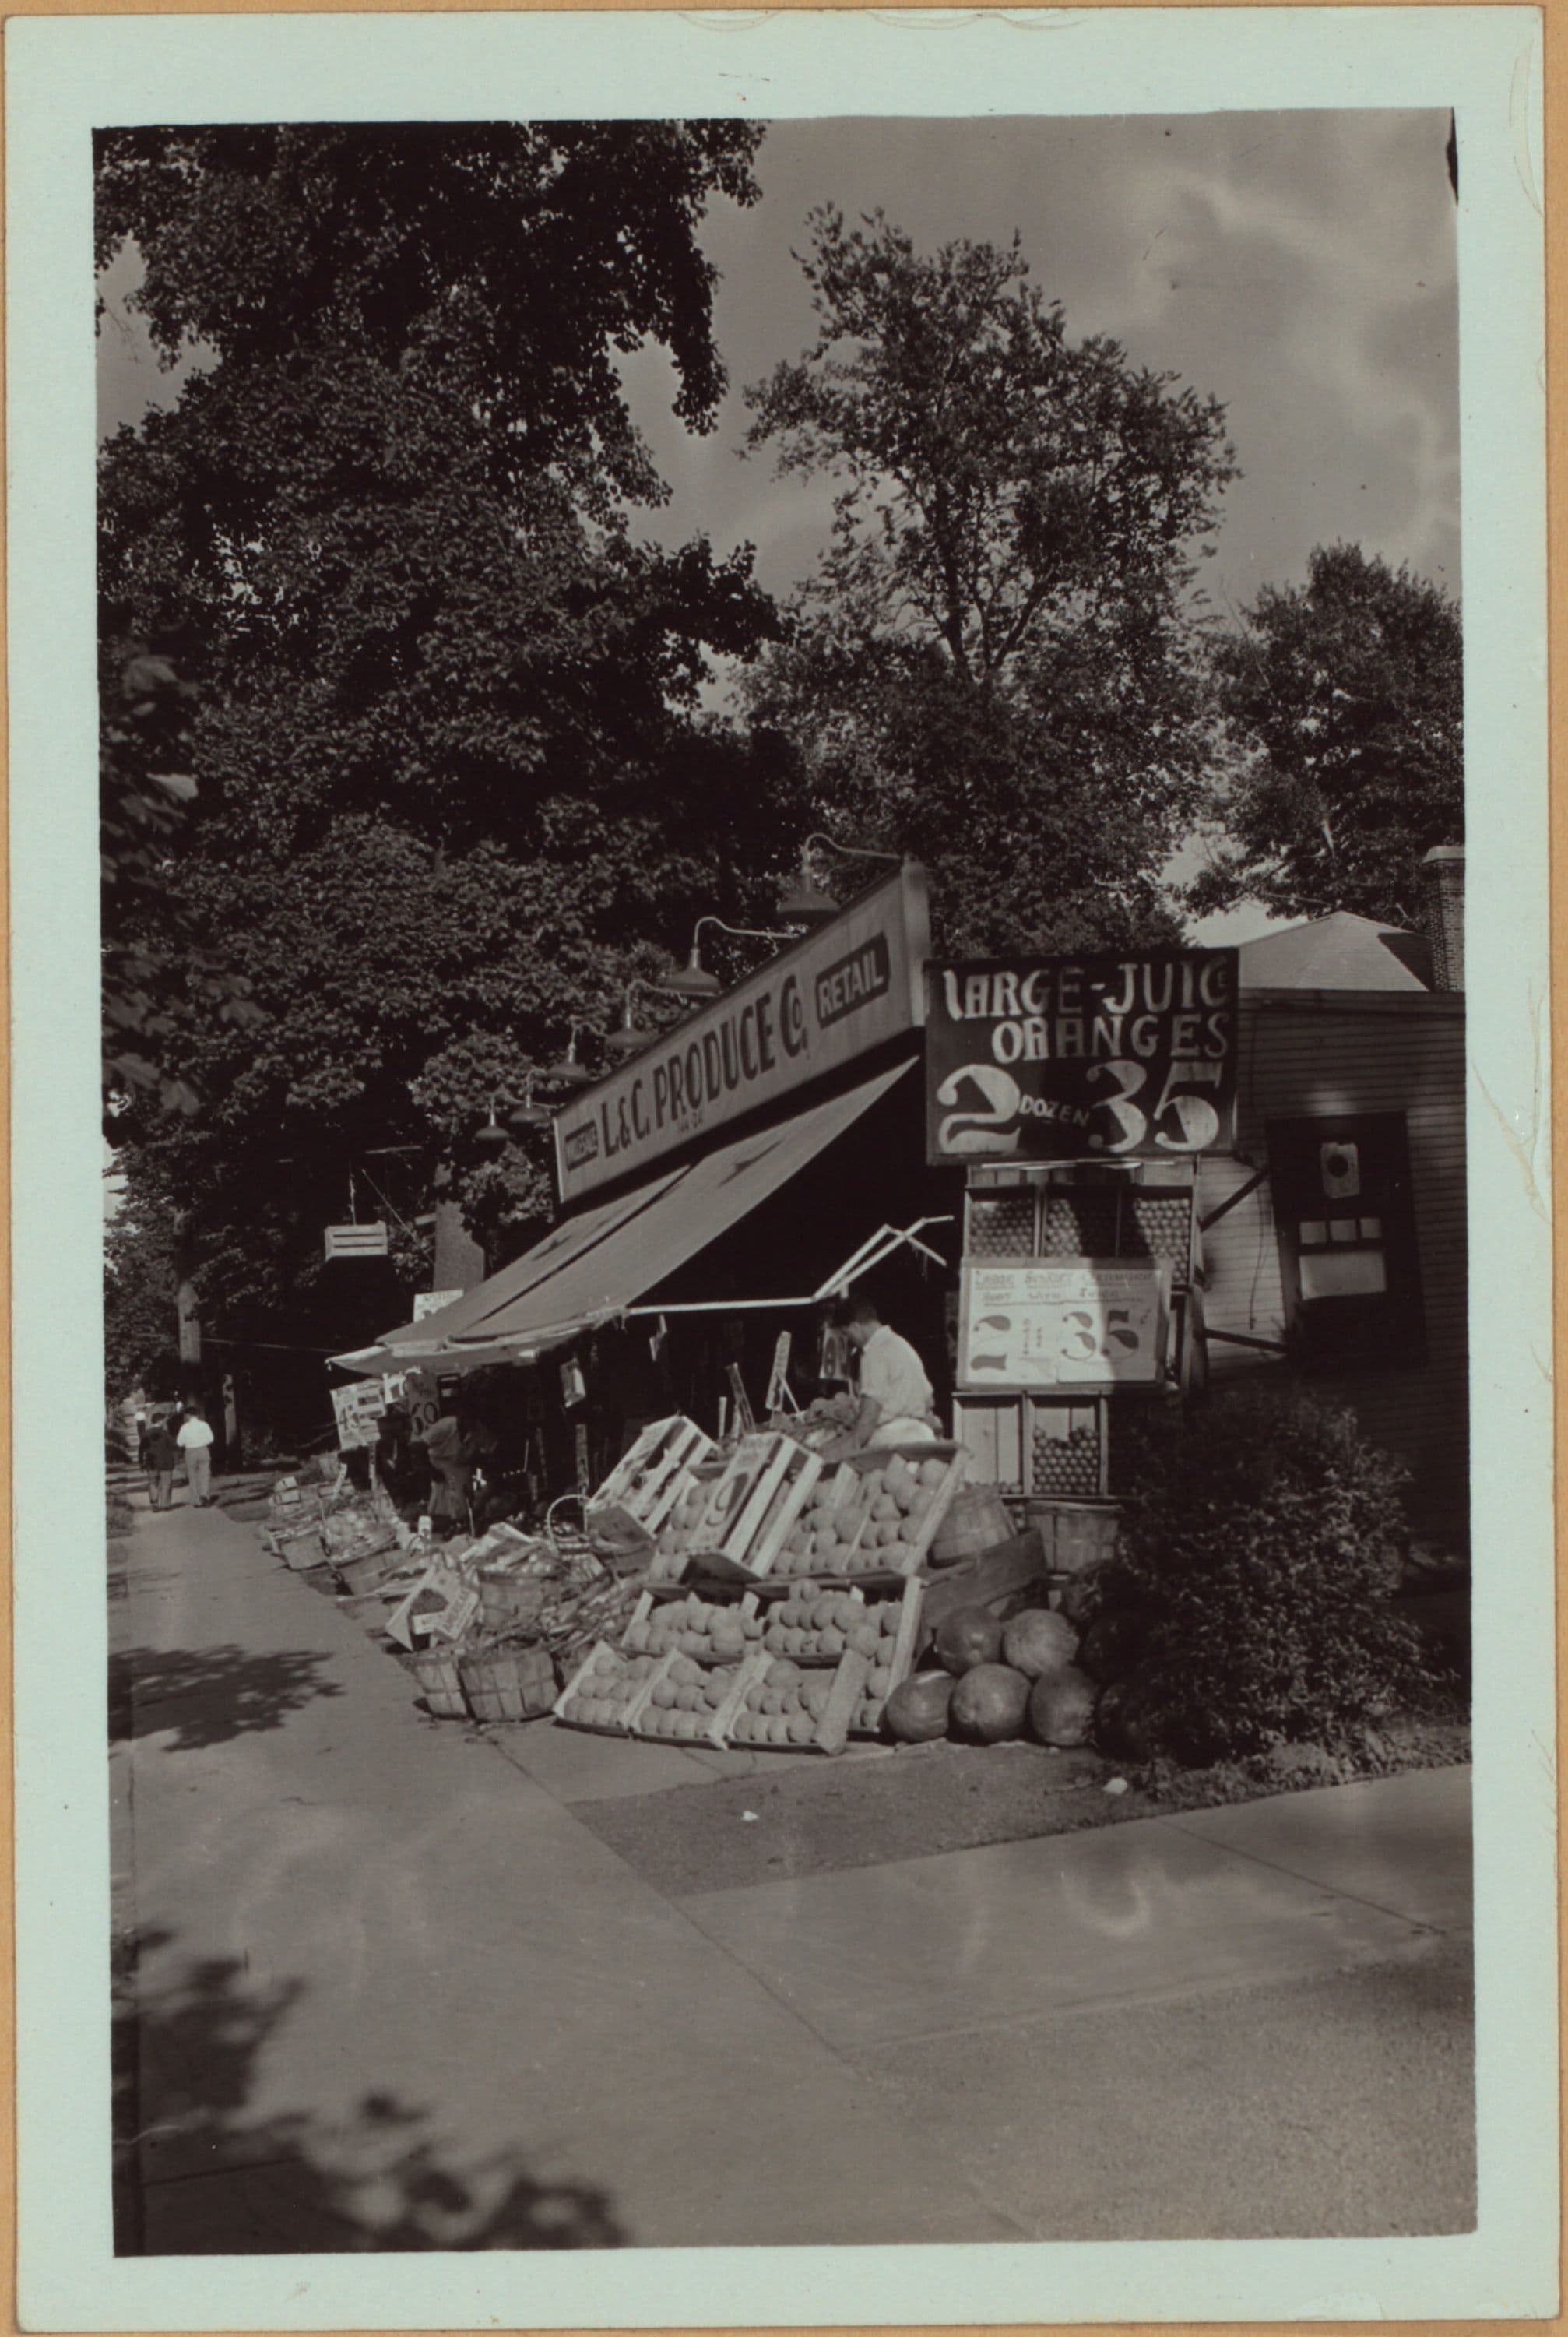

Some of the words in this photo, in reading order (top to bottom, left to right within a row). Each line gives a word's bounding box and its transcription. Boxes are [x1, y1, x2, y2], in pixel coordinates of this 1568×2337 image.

[818, 949, 884, 1019] RETAIL
[653, 992, 776, 1128] PRODUCE
[991, 1014, 1229, 1065] ORANGES
[937, 1064, 1021, 1154] 2
[1019, 1094, 1090, 1125] DOZEN
[1086, 1059, 1223, 1153] 35
